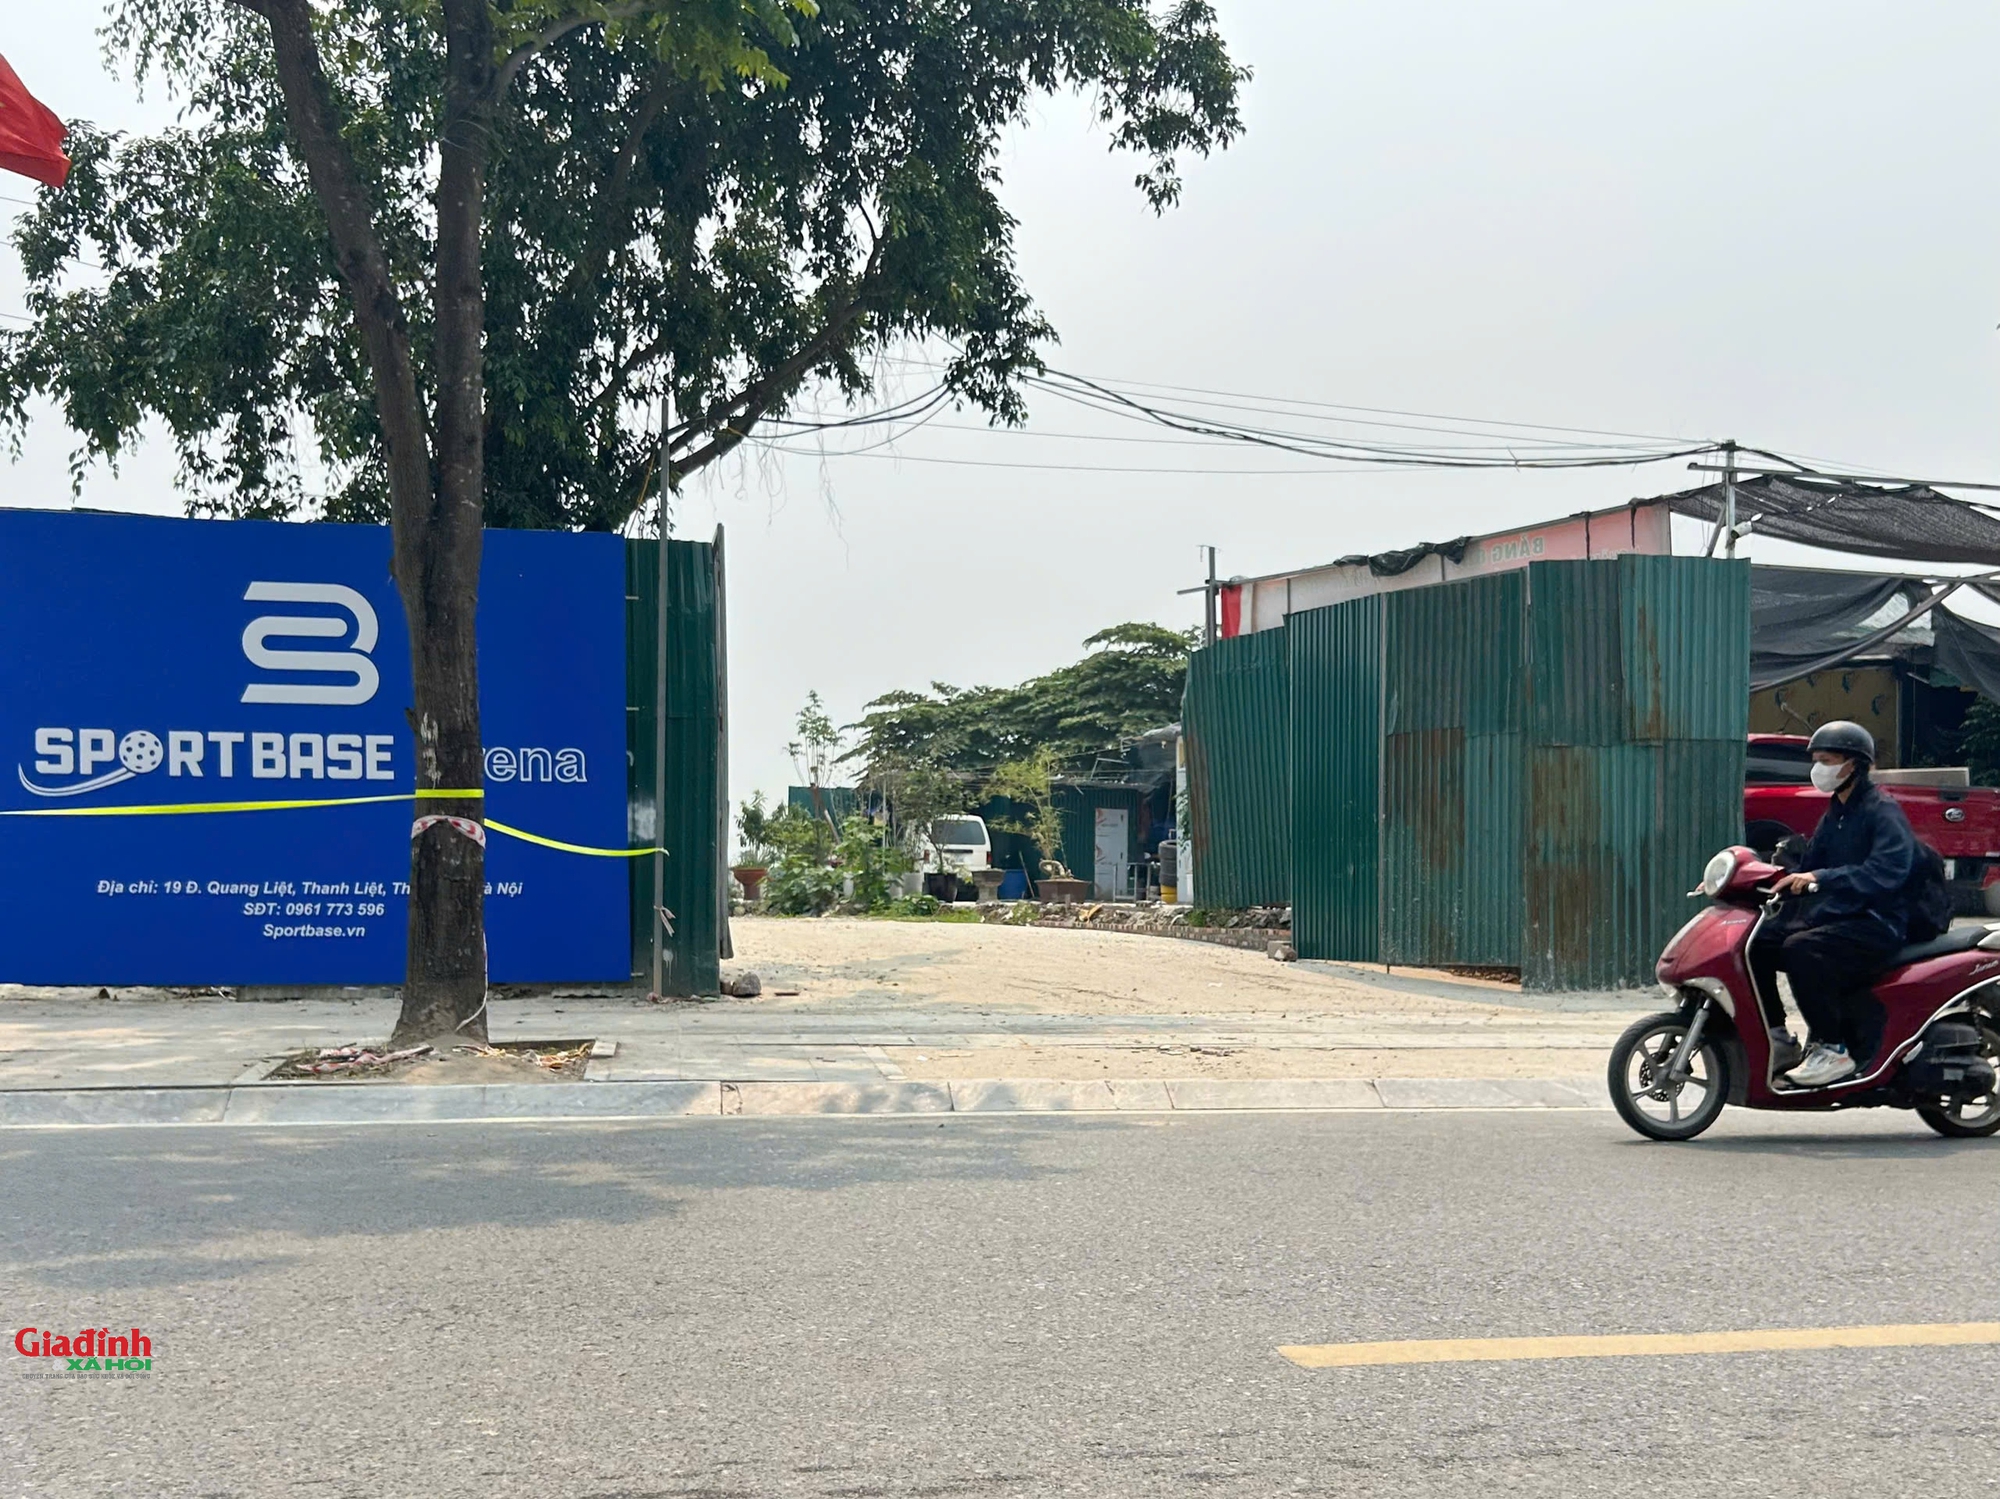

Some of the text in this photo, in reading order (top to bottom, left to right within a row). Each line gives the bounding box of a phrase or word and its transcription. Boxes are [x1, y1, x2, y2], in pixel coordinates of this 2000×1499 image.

[482, 747, 588, 783] ena
[97, 880, 124, 896] Địa
[128, 880, 158, 894] chỉ:
[163, 881, 182, 894] 19
[186, 881, 202, 894] Đ.
[207, 881, 259, 897] Quang
[263, 881, 297, 897] Liệt,
[302, 881, 350, 895] Thanh
[354, 882, 387, 898] Liệt,
[392, 882, 411, 895] Th
[497, 882, 523, 897] Nội
[243, 903, 385, 916] SĐT: 0961 773 596
[263, 924, 366, 940] Sportbase.vn
